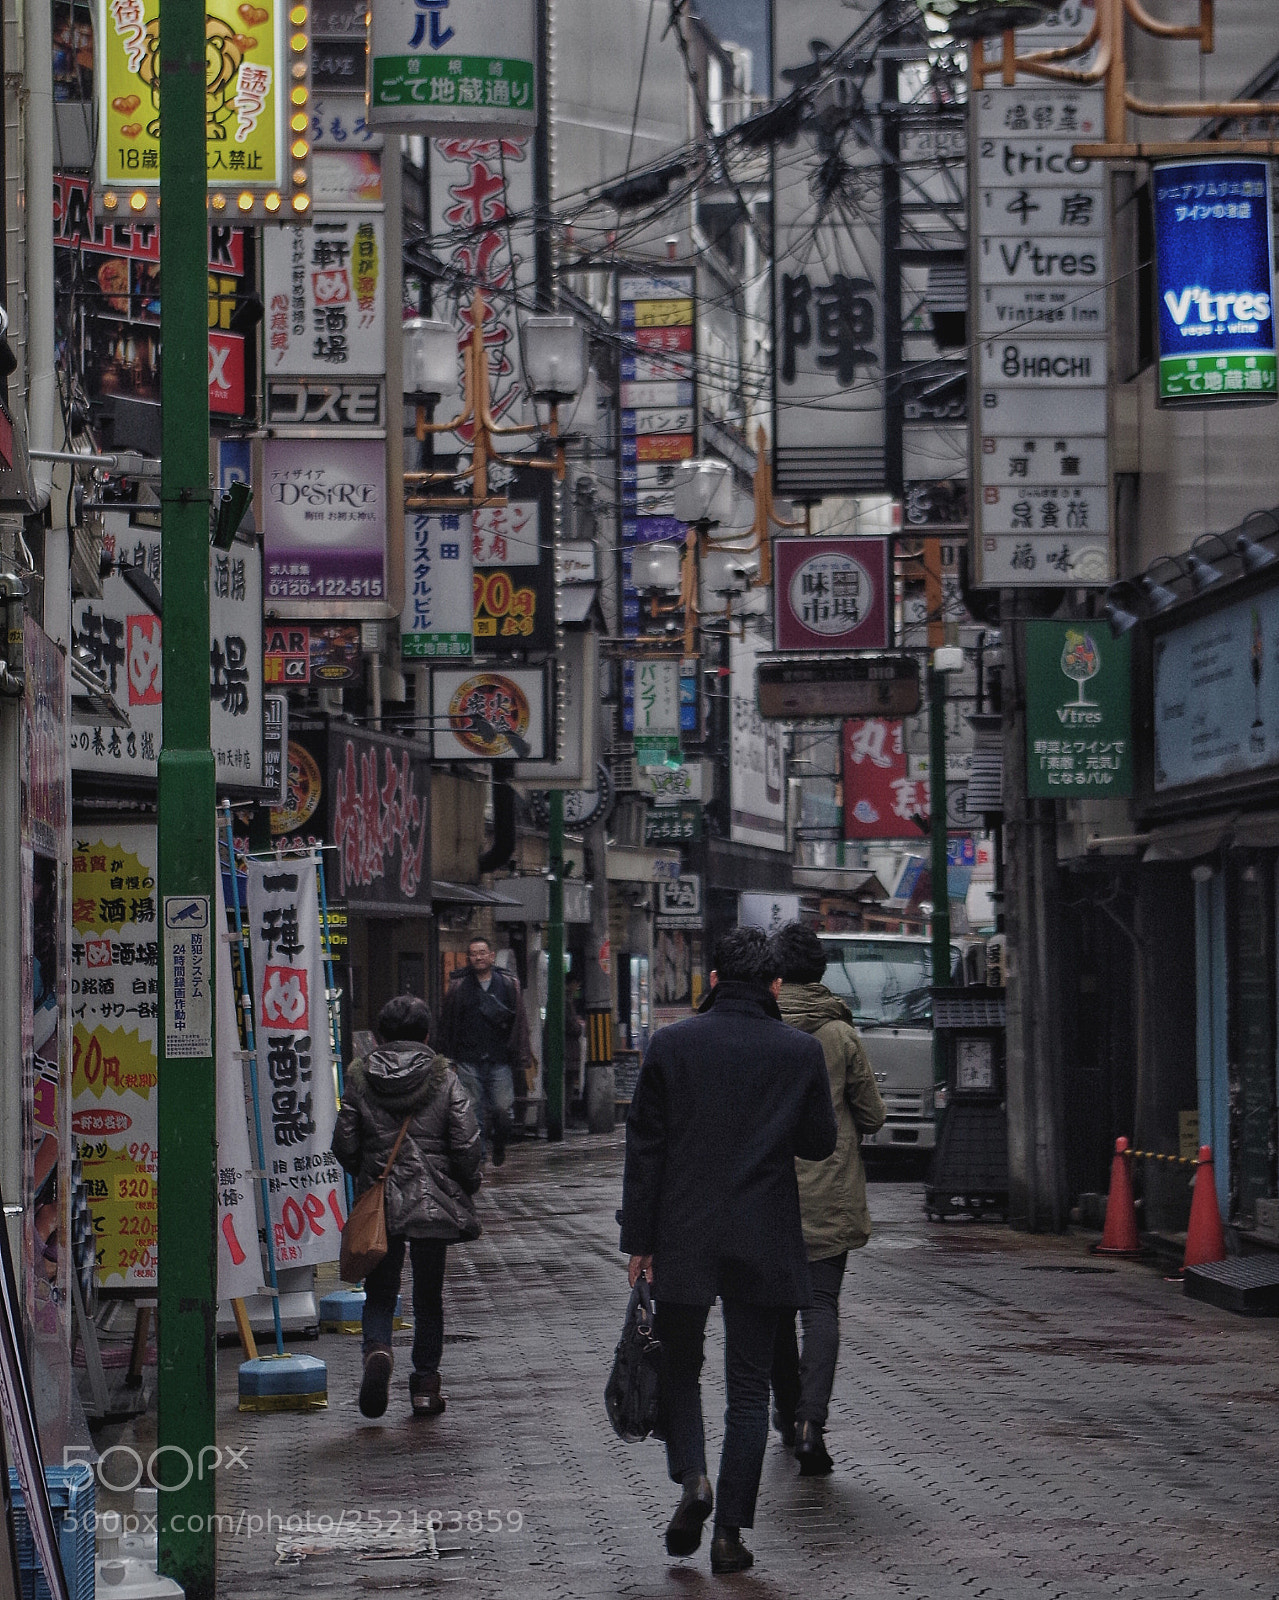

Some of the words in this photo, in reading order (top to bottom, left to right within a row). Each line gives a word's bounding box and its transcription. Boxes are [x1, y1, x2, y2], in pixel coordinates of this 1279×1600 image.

[380, 76, 529, 106] ごて地蔵通り
[981, 141, 995, 158] 2
[1003, 145, 1090, 176] trico
[1000, 240, 1097, 276] V'tres
[311, 223, 352, 364] 一軒め酒場
[1163, 286, 1272, 325] V'tres
[1227, 320, 1259, 335] wine
[1166, 369, 1276, 393] ごて地蔵通り
[271, 384, 378, 423] コスモ
[268, 579, 382, 597] 0120-122-515
[411, 515, 434, 630] クリスタルビル
[110, 876, 155, 889] 自慢の
[191, 933, 203, 998] 防犯システム
[172, 944, 187, 1031] 24時間録画作動中
